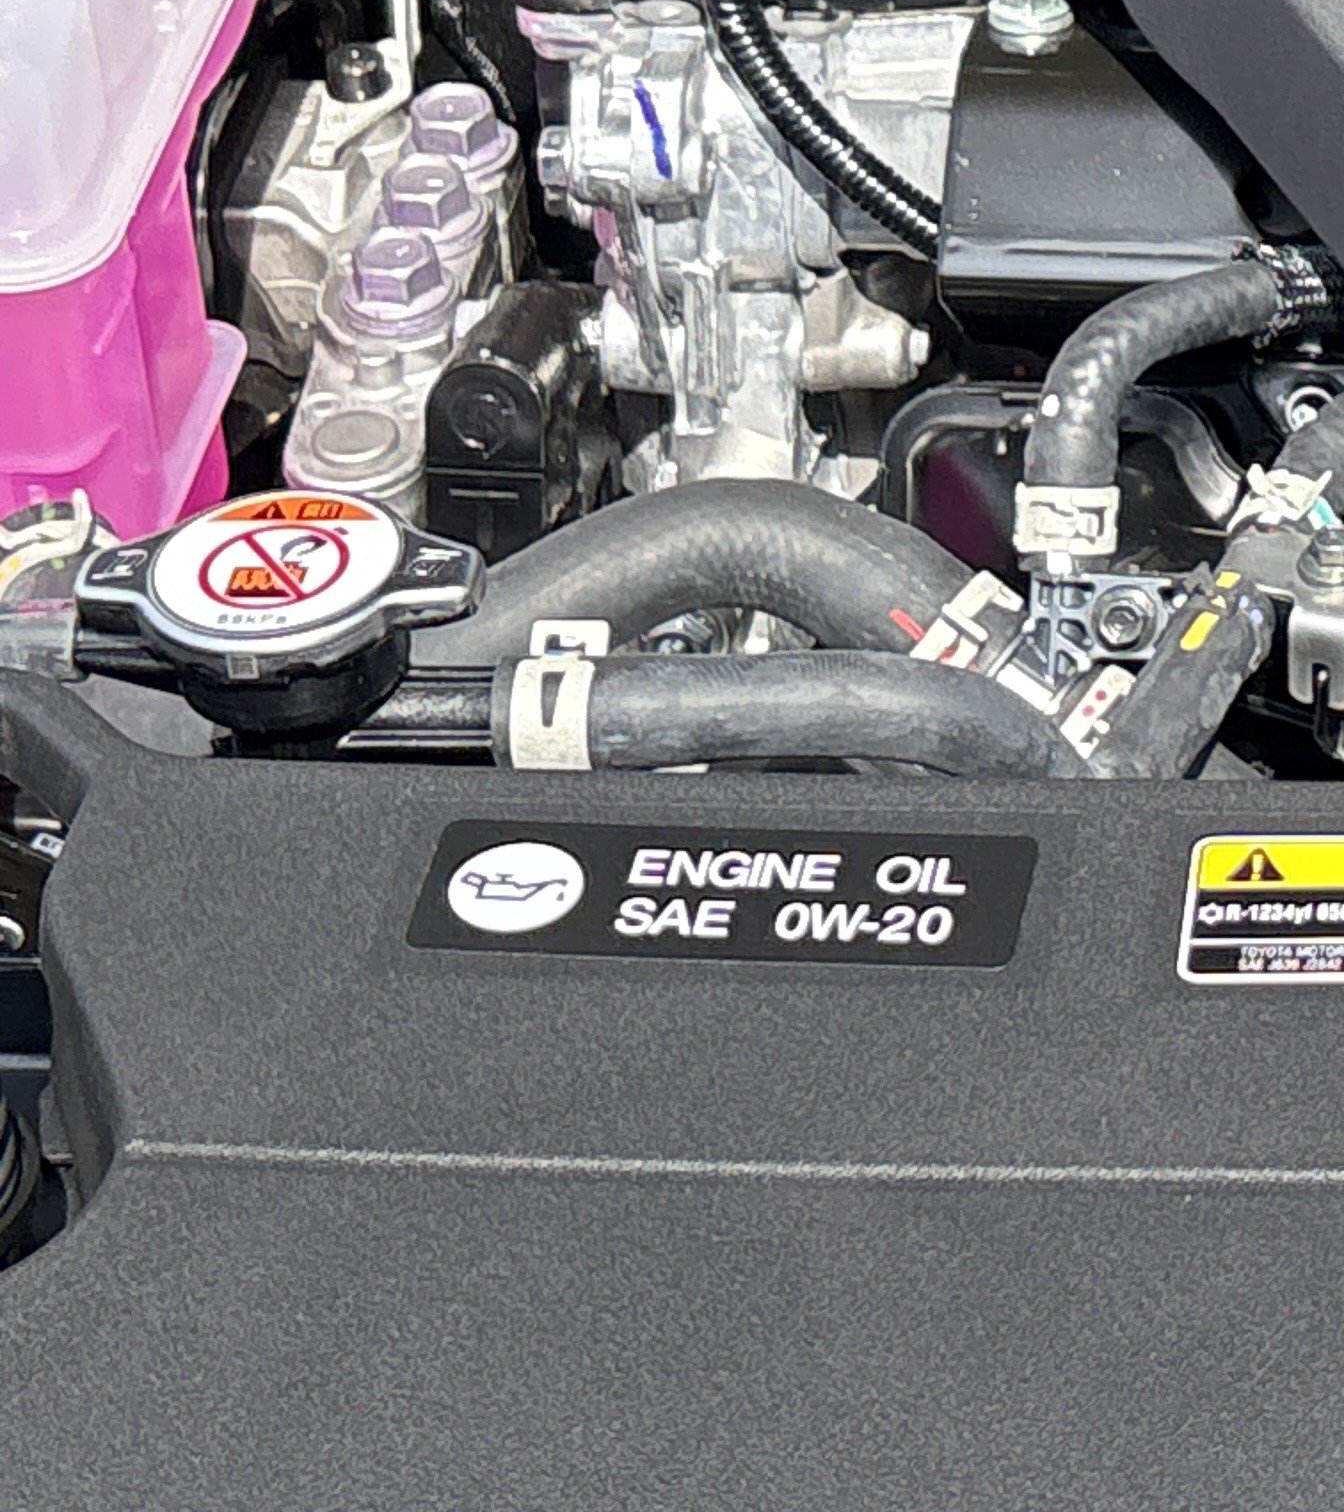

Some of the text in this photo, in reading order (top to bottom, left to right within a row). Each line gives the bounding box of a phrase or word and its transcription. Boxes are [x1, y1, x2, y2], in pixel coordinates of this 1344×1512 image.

[626, 848, 967, 894] ENGINE OIL
[613, 895, 954, 946] SAE 0W-20
[1240, 944, 1292, 958] TOYOTA
[1295, 944, 1344, 958] MOTOR
